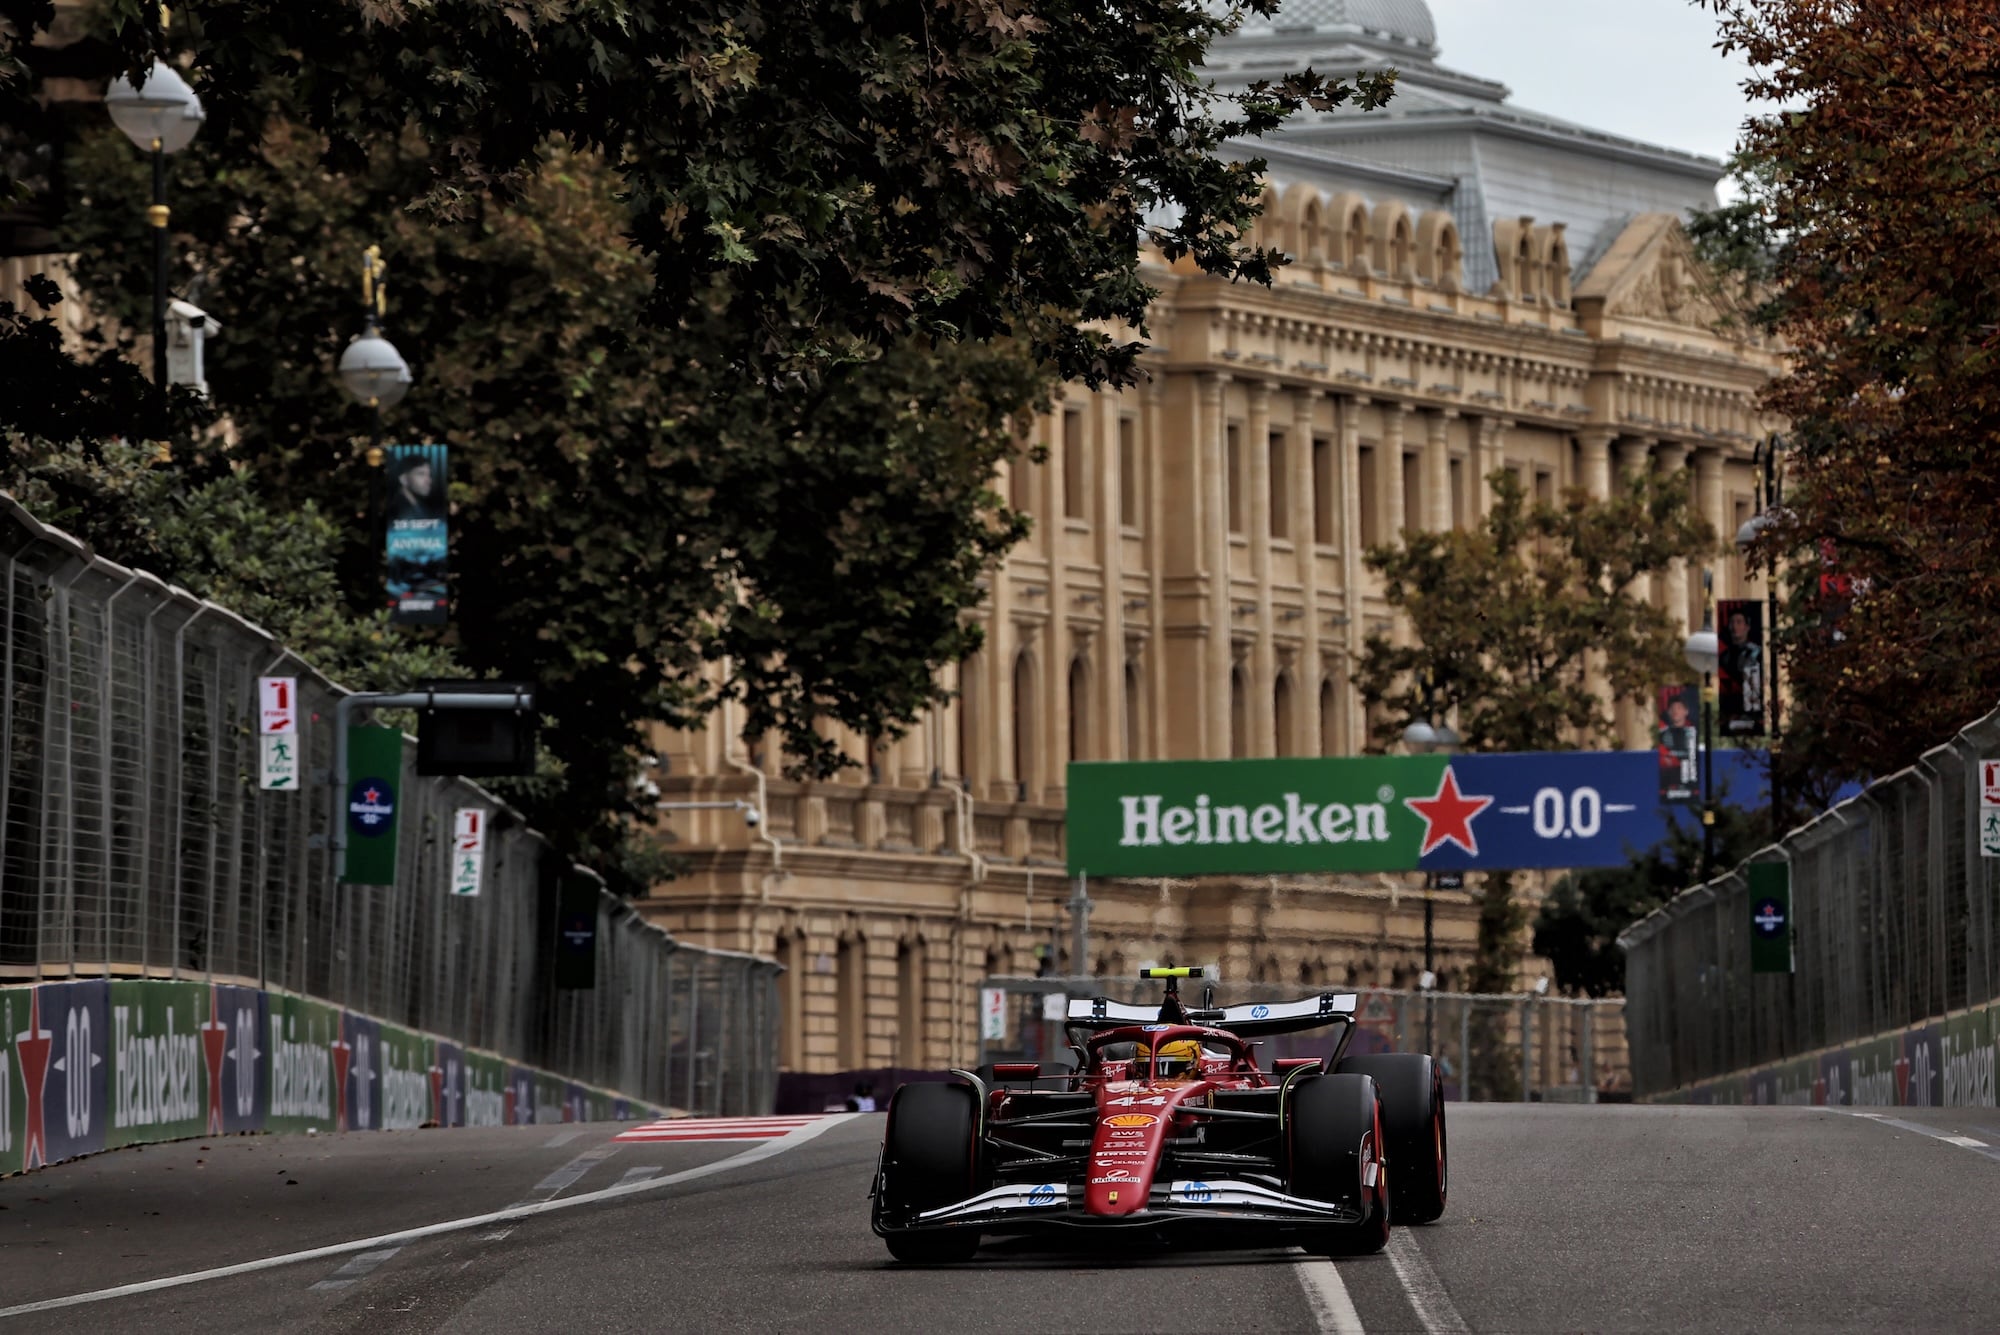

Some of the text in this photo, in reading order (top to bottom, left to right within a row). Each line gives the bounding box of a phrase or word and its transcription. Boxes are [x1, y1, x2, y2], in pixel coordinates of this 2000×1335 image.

[1119, 786, 1601, 846] Heineken 0.0
[66, 1006, 91, 1139] 0.0
[114, 1005, 199, 1128] Heineken
[271, 1014, 330, 1120] Heineken
[1106, 1097, 1167, 1106] 44
[1914, 1029, 1996, 1108] Heineken 00
